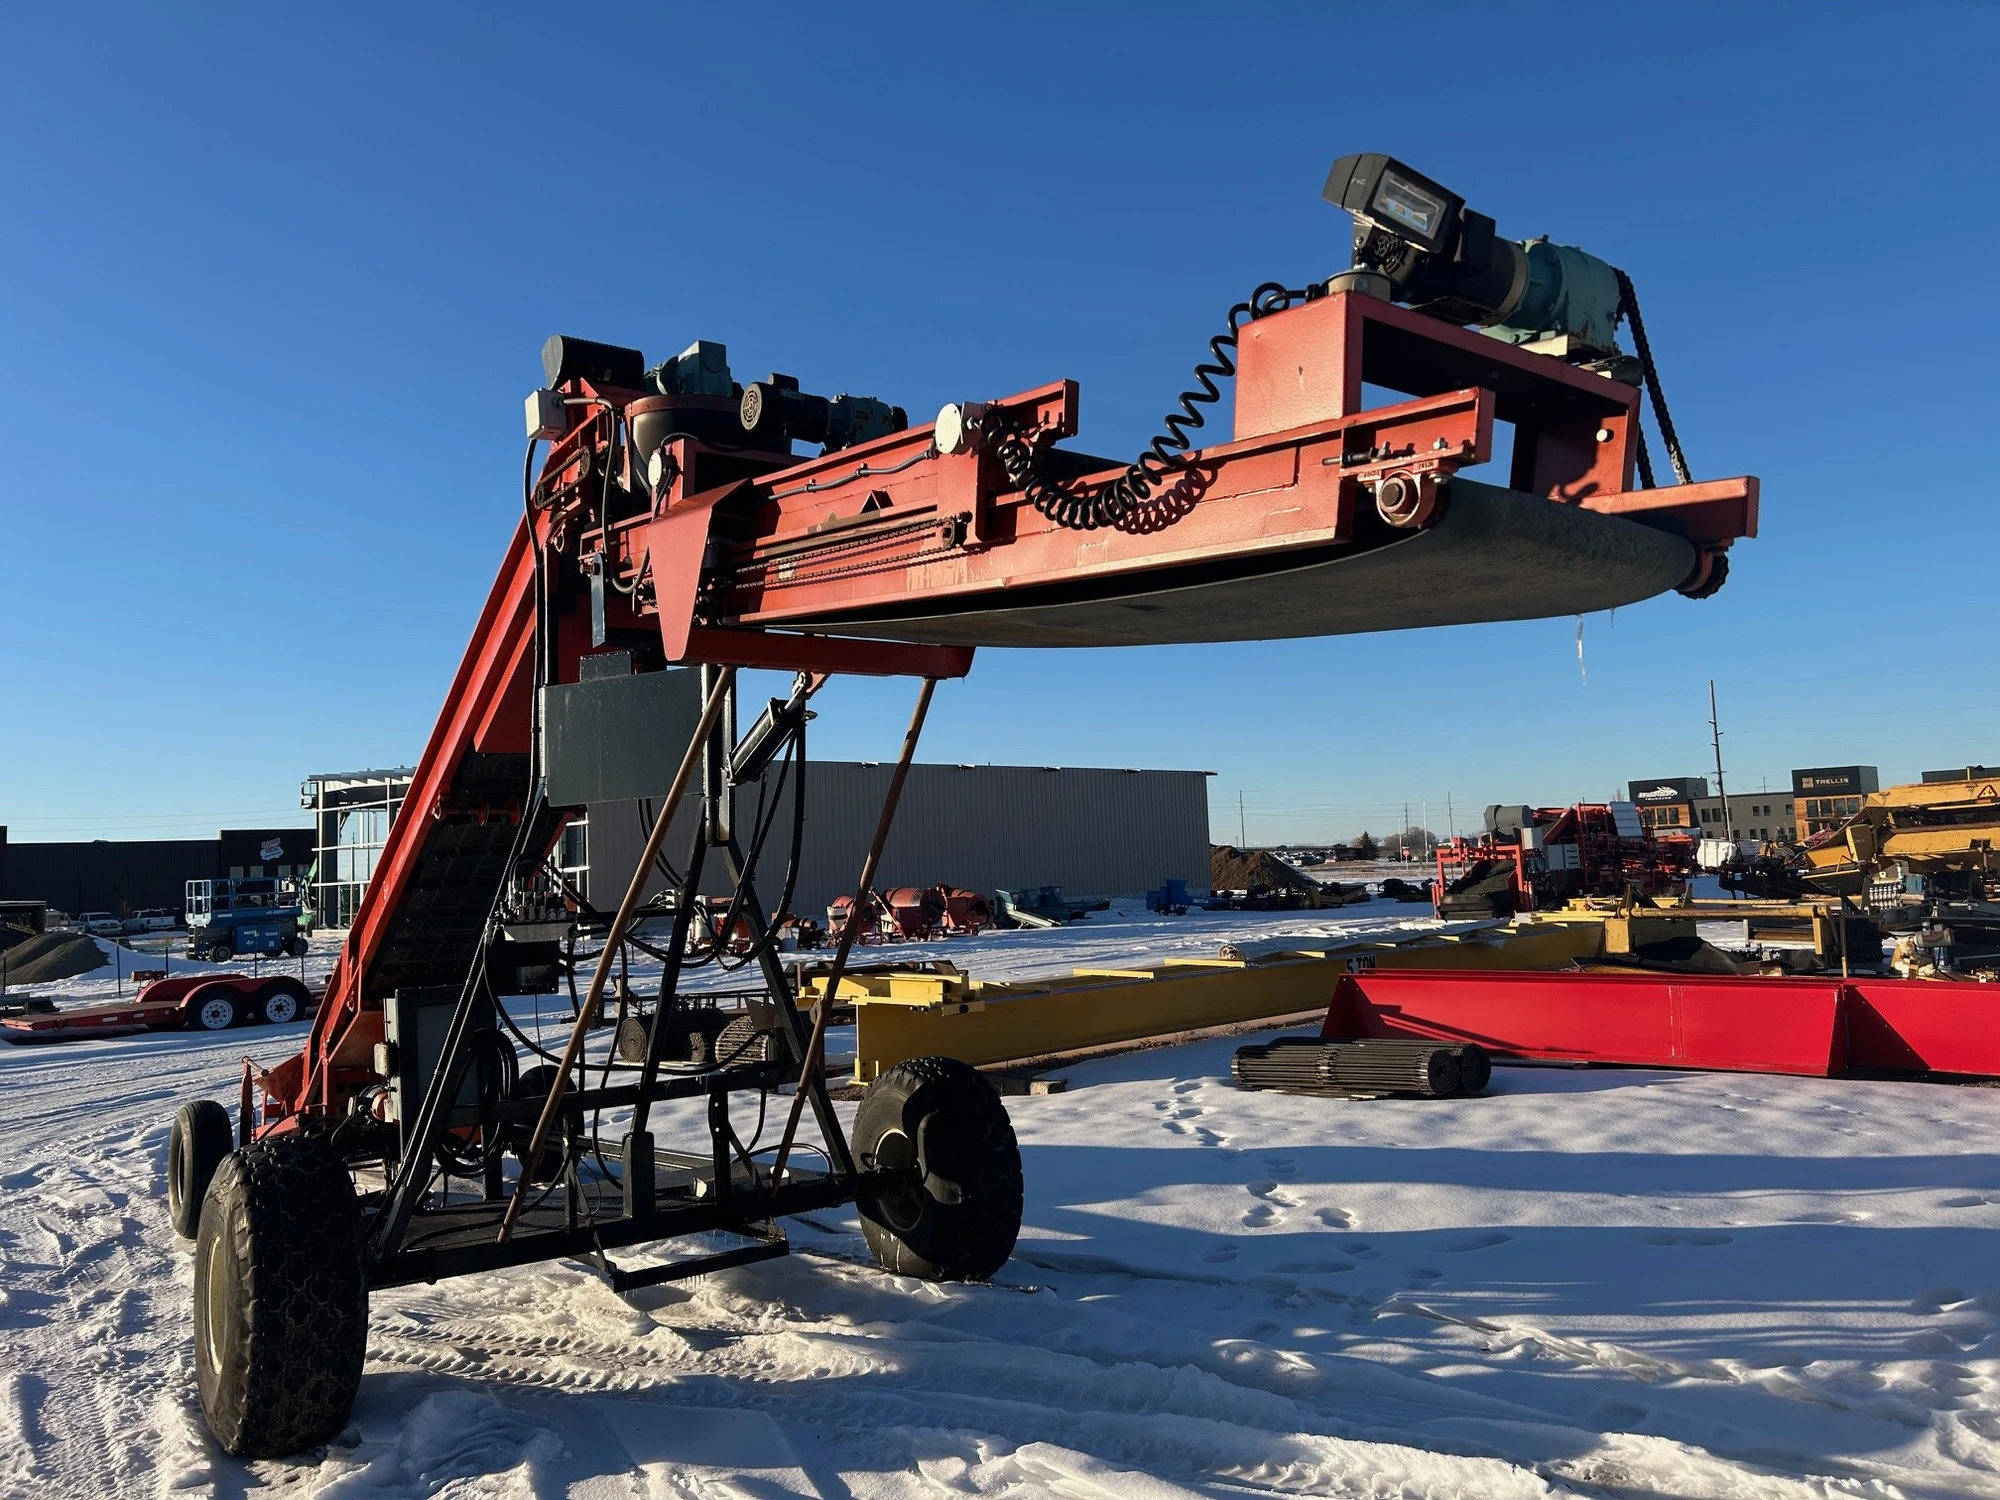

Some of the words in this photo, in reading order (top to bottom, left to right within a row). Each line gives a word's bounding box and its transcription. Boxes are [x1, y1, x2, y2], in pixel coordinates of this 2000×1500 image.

[1815, 777, 1849, 785] TRELLIS
[1346, 958, 1354, 974] 5
[1355, 955, 1376, 969] TON
